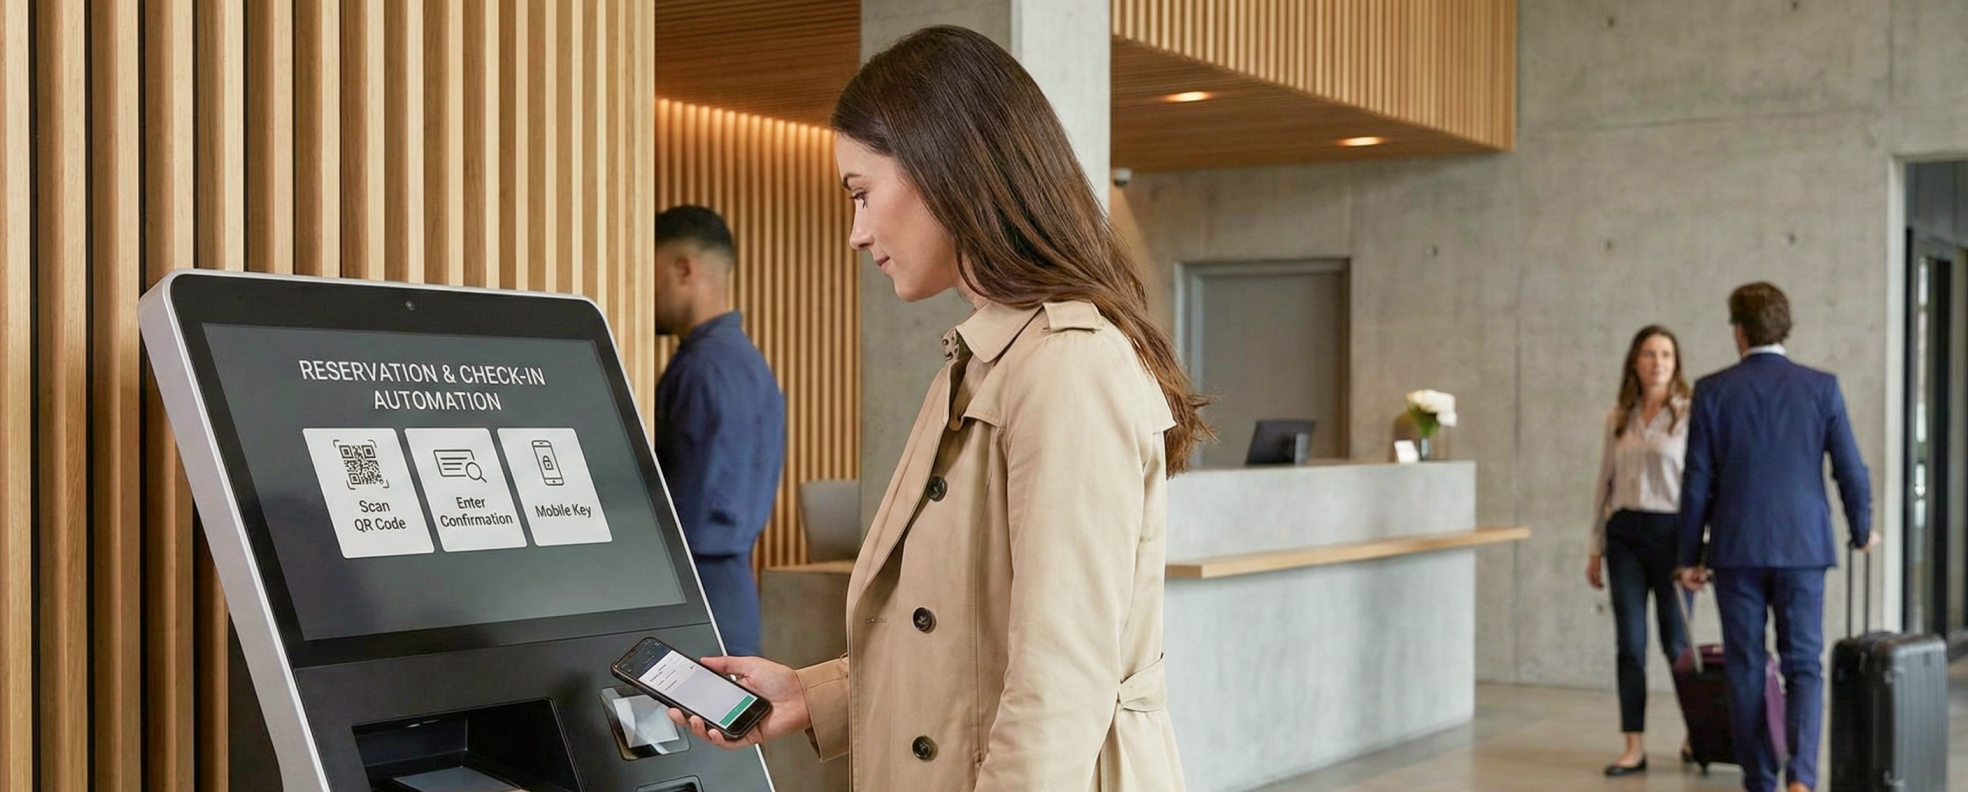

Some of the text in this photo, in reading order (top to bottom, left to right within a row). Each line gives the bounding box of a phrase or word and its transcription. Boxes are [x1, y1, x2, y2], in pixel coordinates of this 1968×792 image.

[299, 360, 546, 385] RESERVATION & CHECK-IN
[374, 390, 502, 411] AUTOMATION
[359, 500, 390, 513] Scan
[456, 496, 486, 510] Enter
[535, 503, 592, 518] Mobile Key
[354, 517, 407, 532] QR Code
[440, 512, 513, 528] Confirmation
